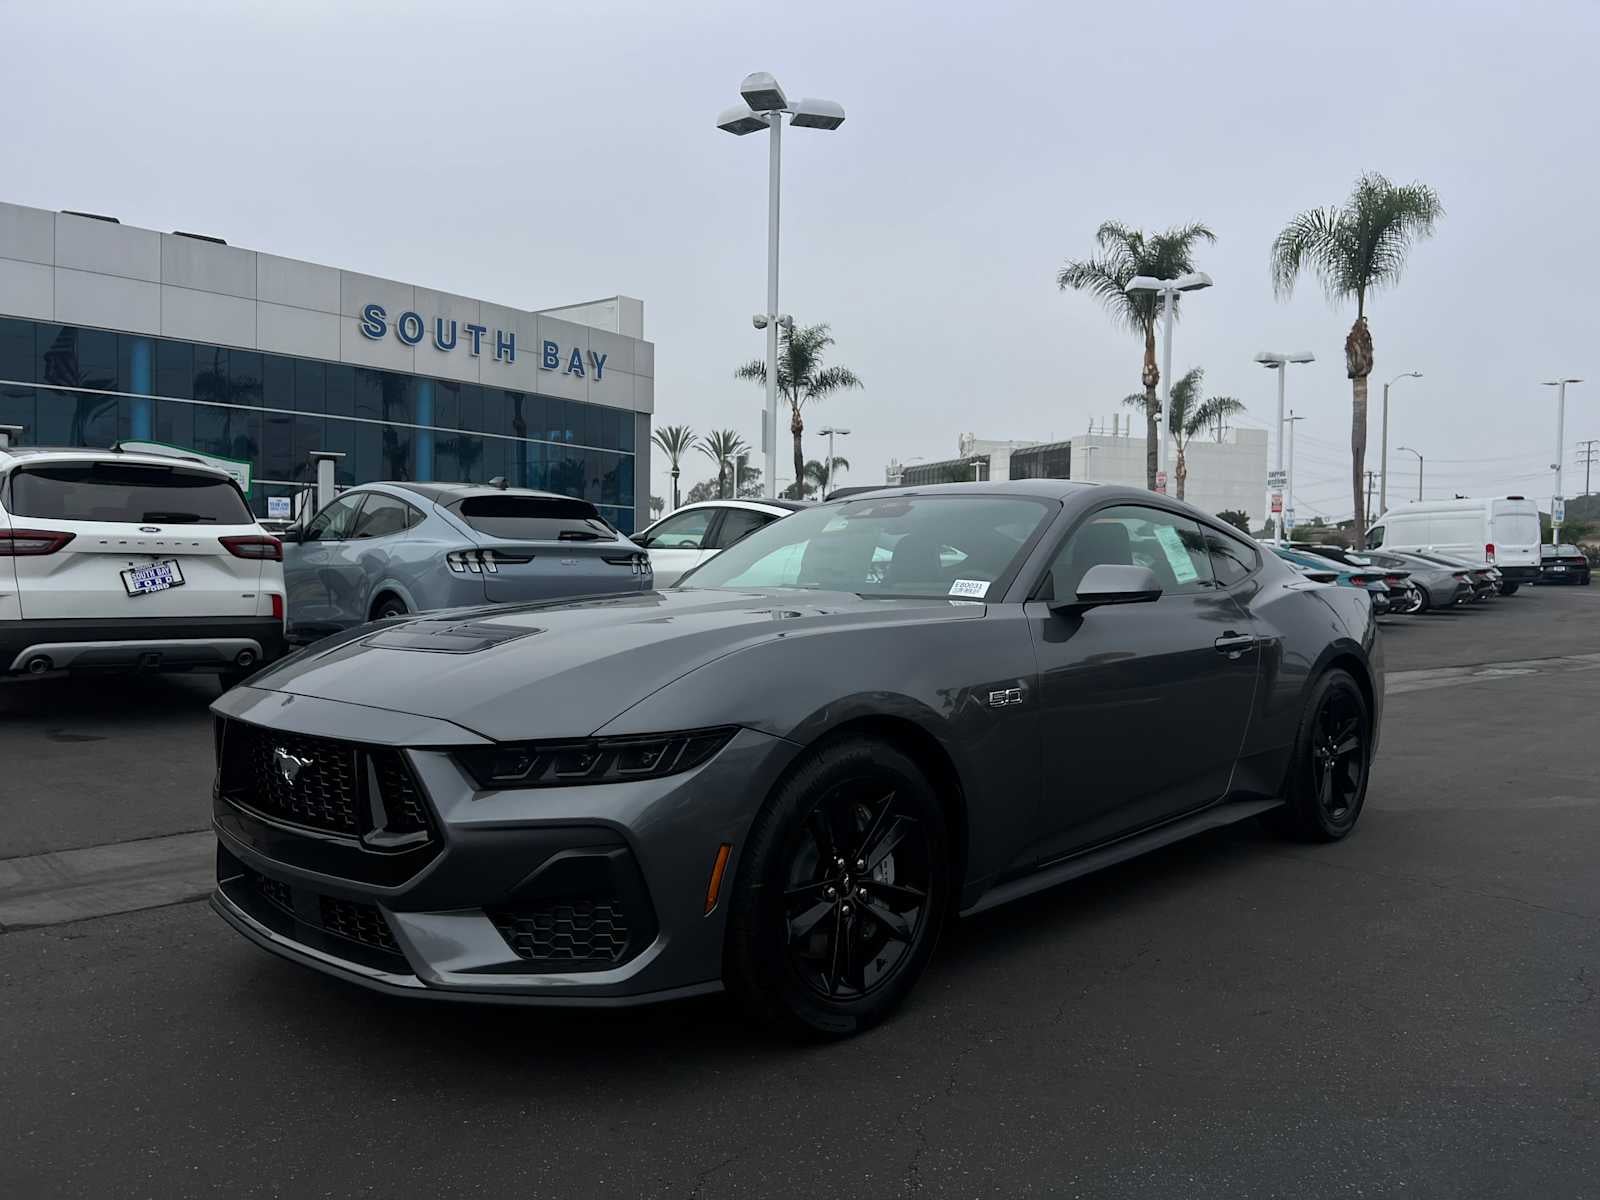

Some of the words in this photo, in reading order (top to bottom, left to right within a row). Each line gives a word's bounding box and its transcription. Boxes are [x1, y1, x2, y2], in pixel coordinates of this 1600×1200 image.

[360, 304, 516, 364] SOUTH
[540, 339, 608, 381] BAY
[131, 568, 155, 580] SOUTH
[156, 566, 172, 577] BAY
[134, 576, 173, 589] FORD
[144, 583, 170, 593] FORD
